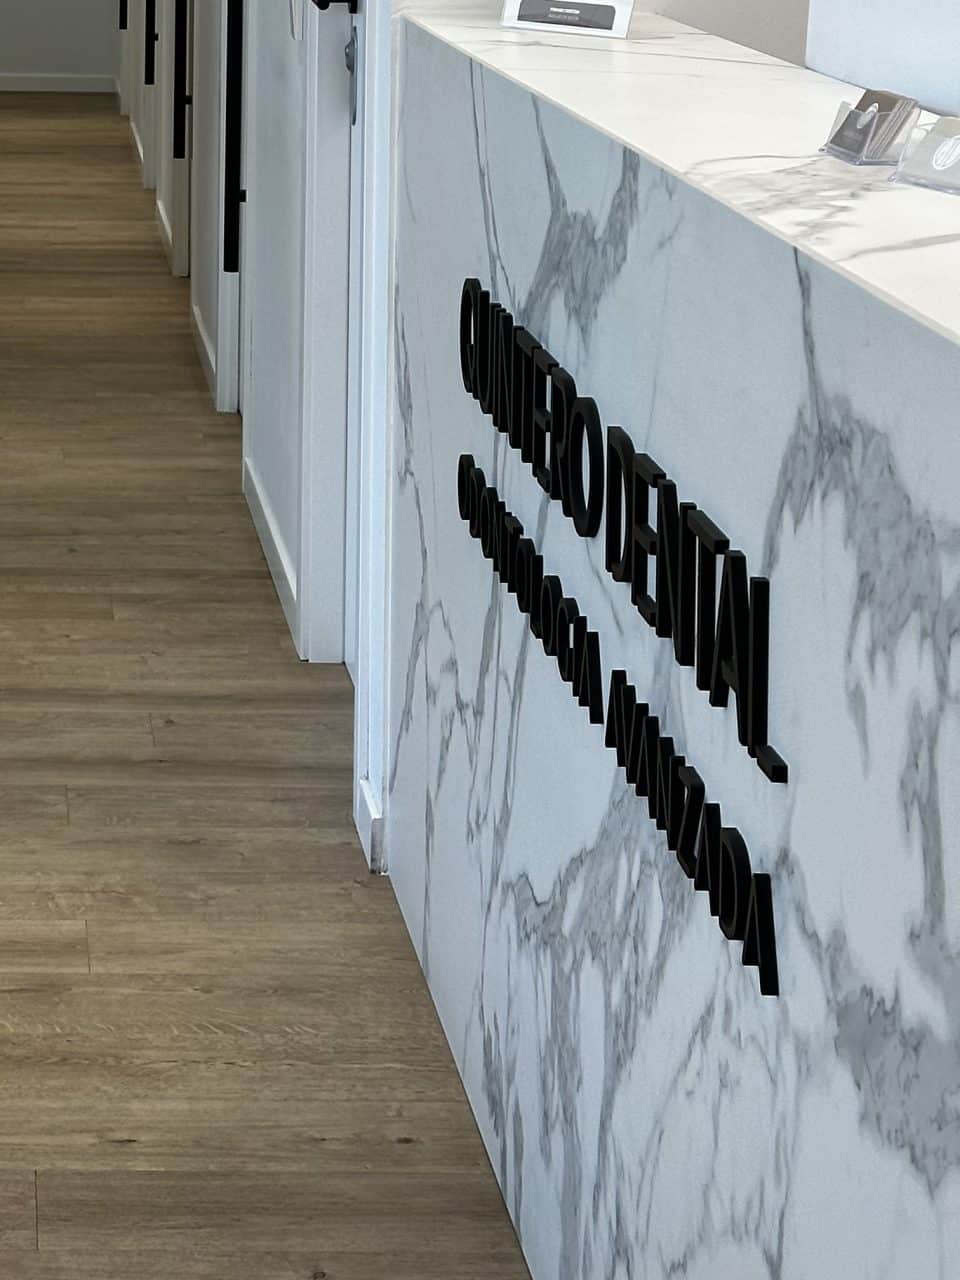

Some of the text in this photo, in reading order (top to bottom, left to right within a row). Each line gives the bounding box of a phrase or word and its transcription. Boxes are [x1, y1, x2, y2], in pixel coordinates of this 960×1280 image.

[460, 278, 788, 783] QUINTERO DENTAL
[605, 670, 779, 996] AVANZADA
